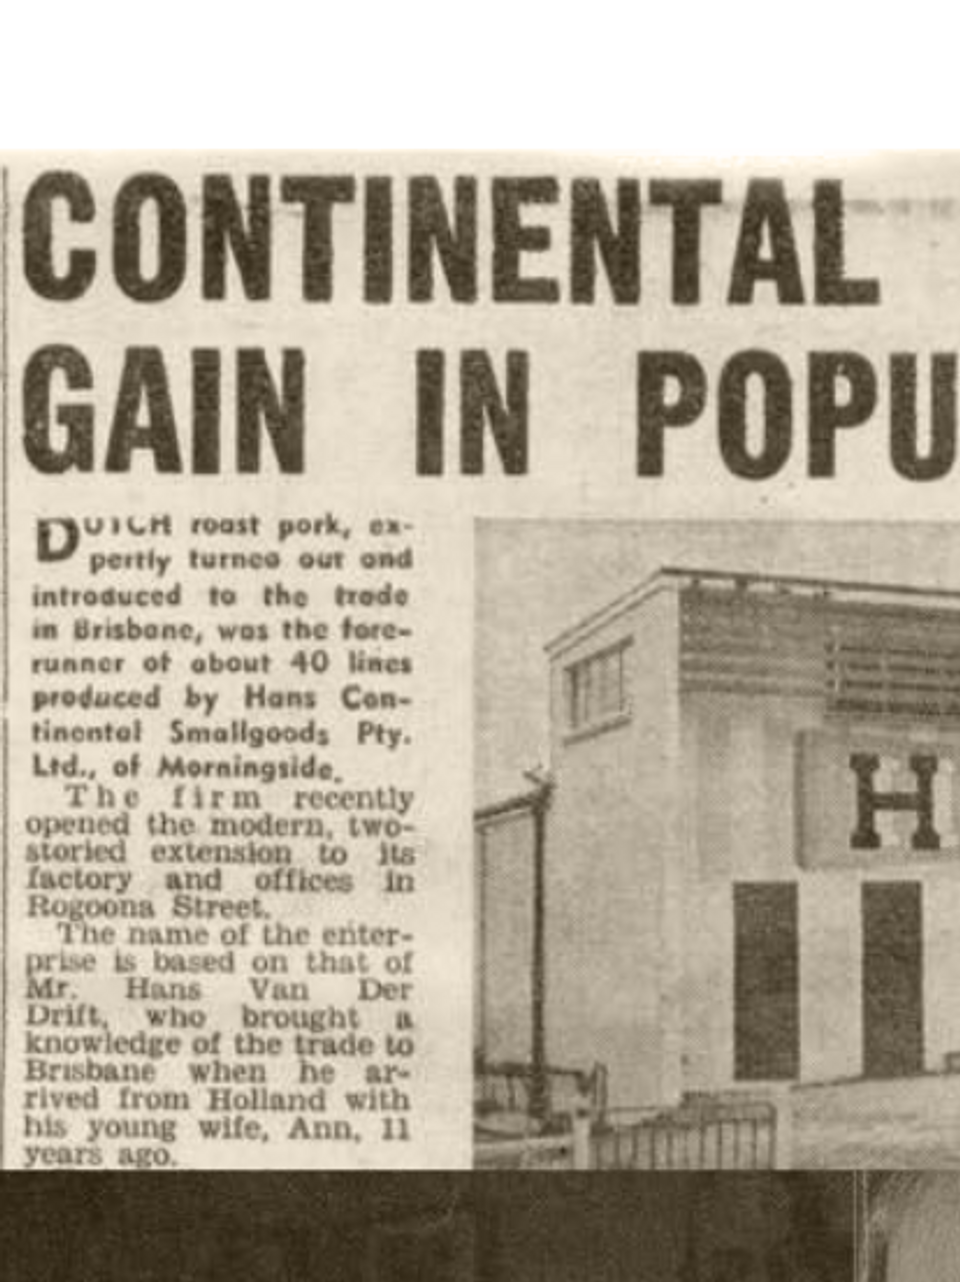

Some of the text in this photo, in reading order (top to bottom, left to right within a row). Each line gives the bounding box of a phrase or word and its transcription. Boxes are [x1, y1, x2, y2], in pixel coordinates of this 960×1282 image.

[21, 170, 880, 305] CONTINENTAL
[21, 344, 306, 474] GAIN
[415, 349, 530, 475] IN
[191, 516, 259, 535] roast
[279, 513, 350, 541] pork,
[370, 520, 412, 535] ex-
[90, 550, 170, 577] pertly
[299, 552, 343, 569] out
[361, 549, 412, 569] and
[33, 583, 408, 608] introduced to the trade
[33, 617, 412, 644] in Brisbane, was the fore-
[32, 650, 412, 674] runner of about 40 lines
[33, 685, 412, 716] produced by Hans Con-
[33, 719, 410, 750] tinental Smallgoods Pty.
[33, 754, 341, 783] Ltd., of Morningside.
[66, 784, 414, 814] The firm recently
[26, 812, 415, 839] opened the modern, two-
[26, 841, 415, 865] storied extension to its
[28, 866, 414, 893] factory and offices in
[28, 894, 269, 920] Rogoona Street.
[58, 922, 412, 946] The name of the enter-
[26, 951, 412, 975] prise is based on that of
[26, 977, 412, 1000] Mr. Hans Van Der
[27, 1005, 414, 1032] Drift, who brought a
[27, 1031, 415, 1058] knowledge of the trade to
[26, 1058, 412, 1084] Brisbane when he ar-
[25, 1087, 410, 1111] rived from Holland with
[25, 1115, 408, 1142] his young wife, Ann, 11
[25, 1145, 177, 1169] years ago.
